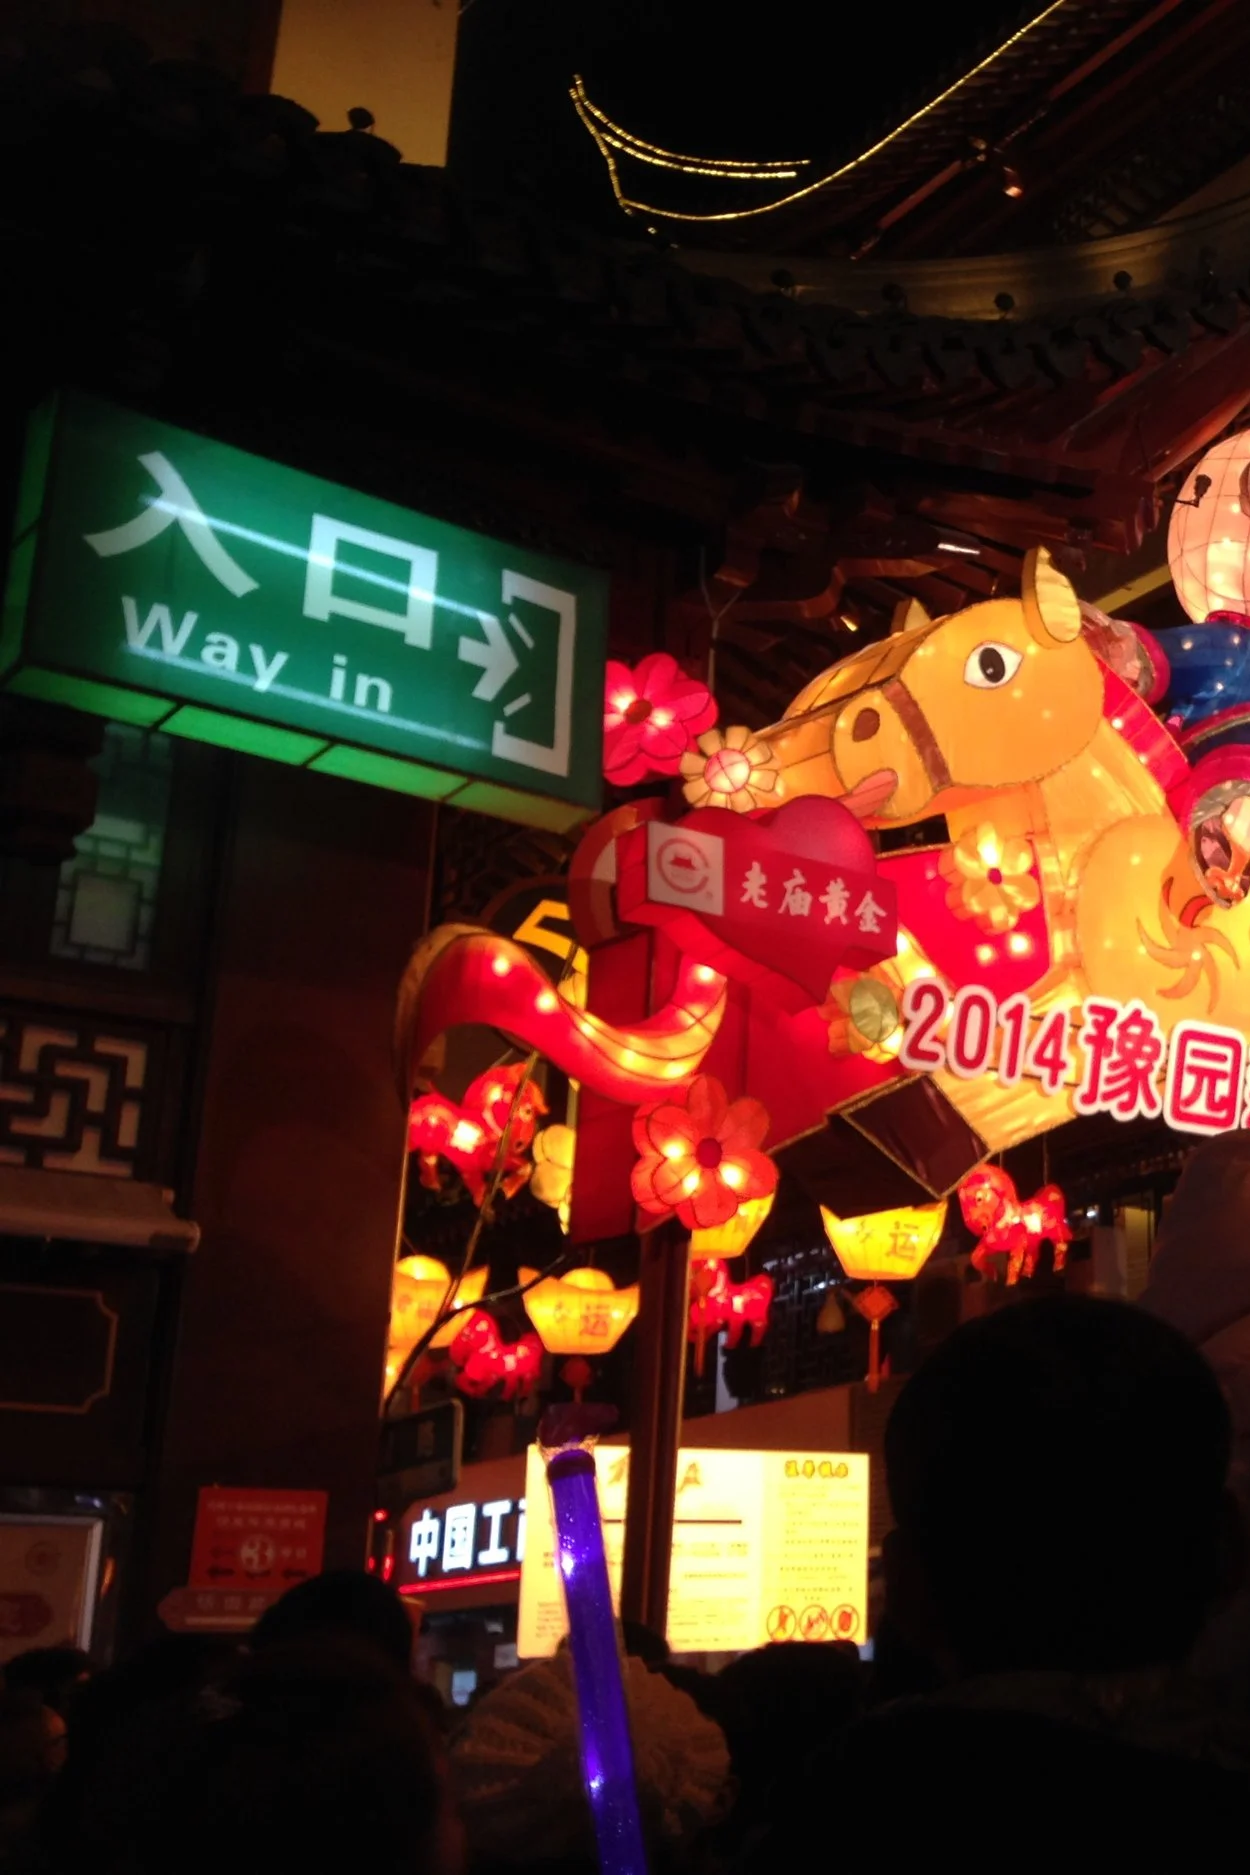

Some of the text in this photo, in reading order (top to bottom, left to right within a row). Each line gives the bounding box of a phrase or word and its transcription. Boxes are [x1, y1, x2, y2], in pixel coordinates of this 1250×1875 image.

[84, 450, 439, 650] 入口
[121, 595, 394, 714] Way in
[740, 860, 887, 934] 老庙黄金
